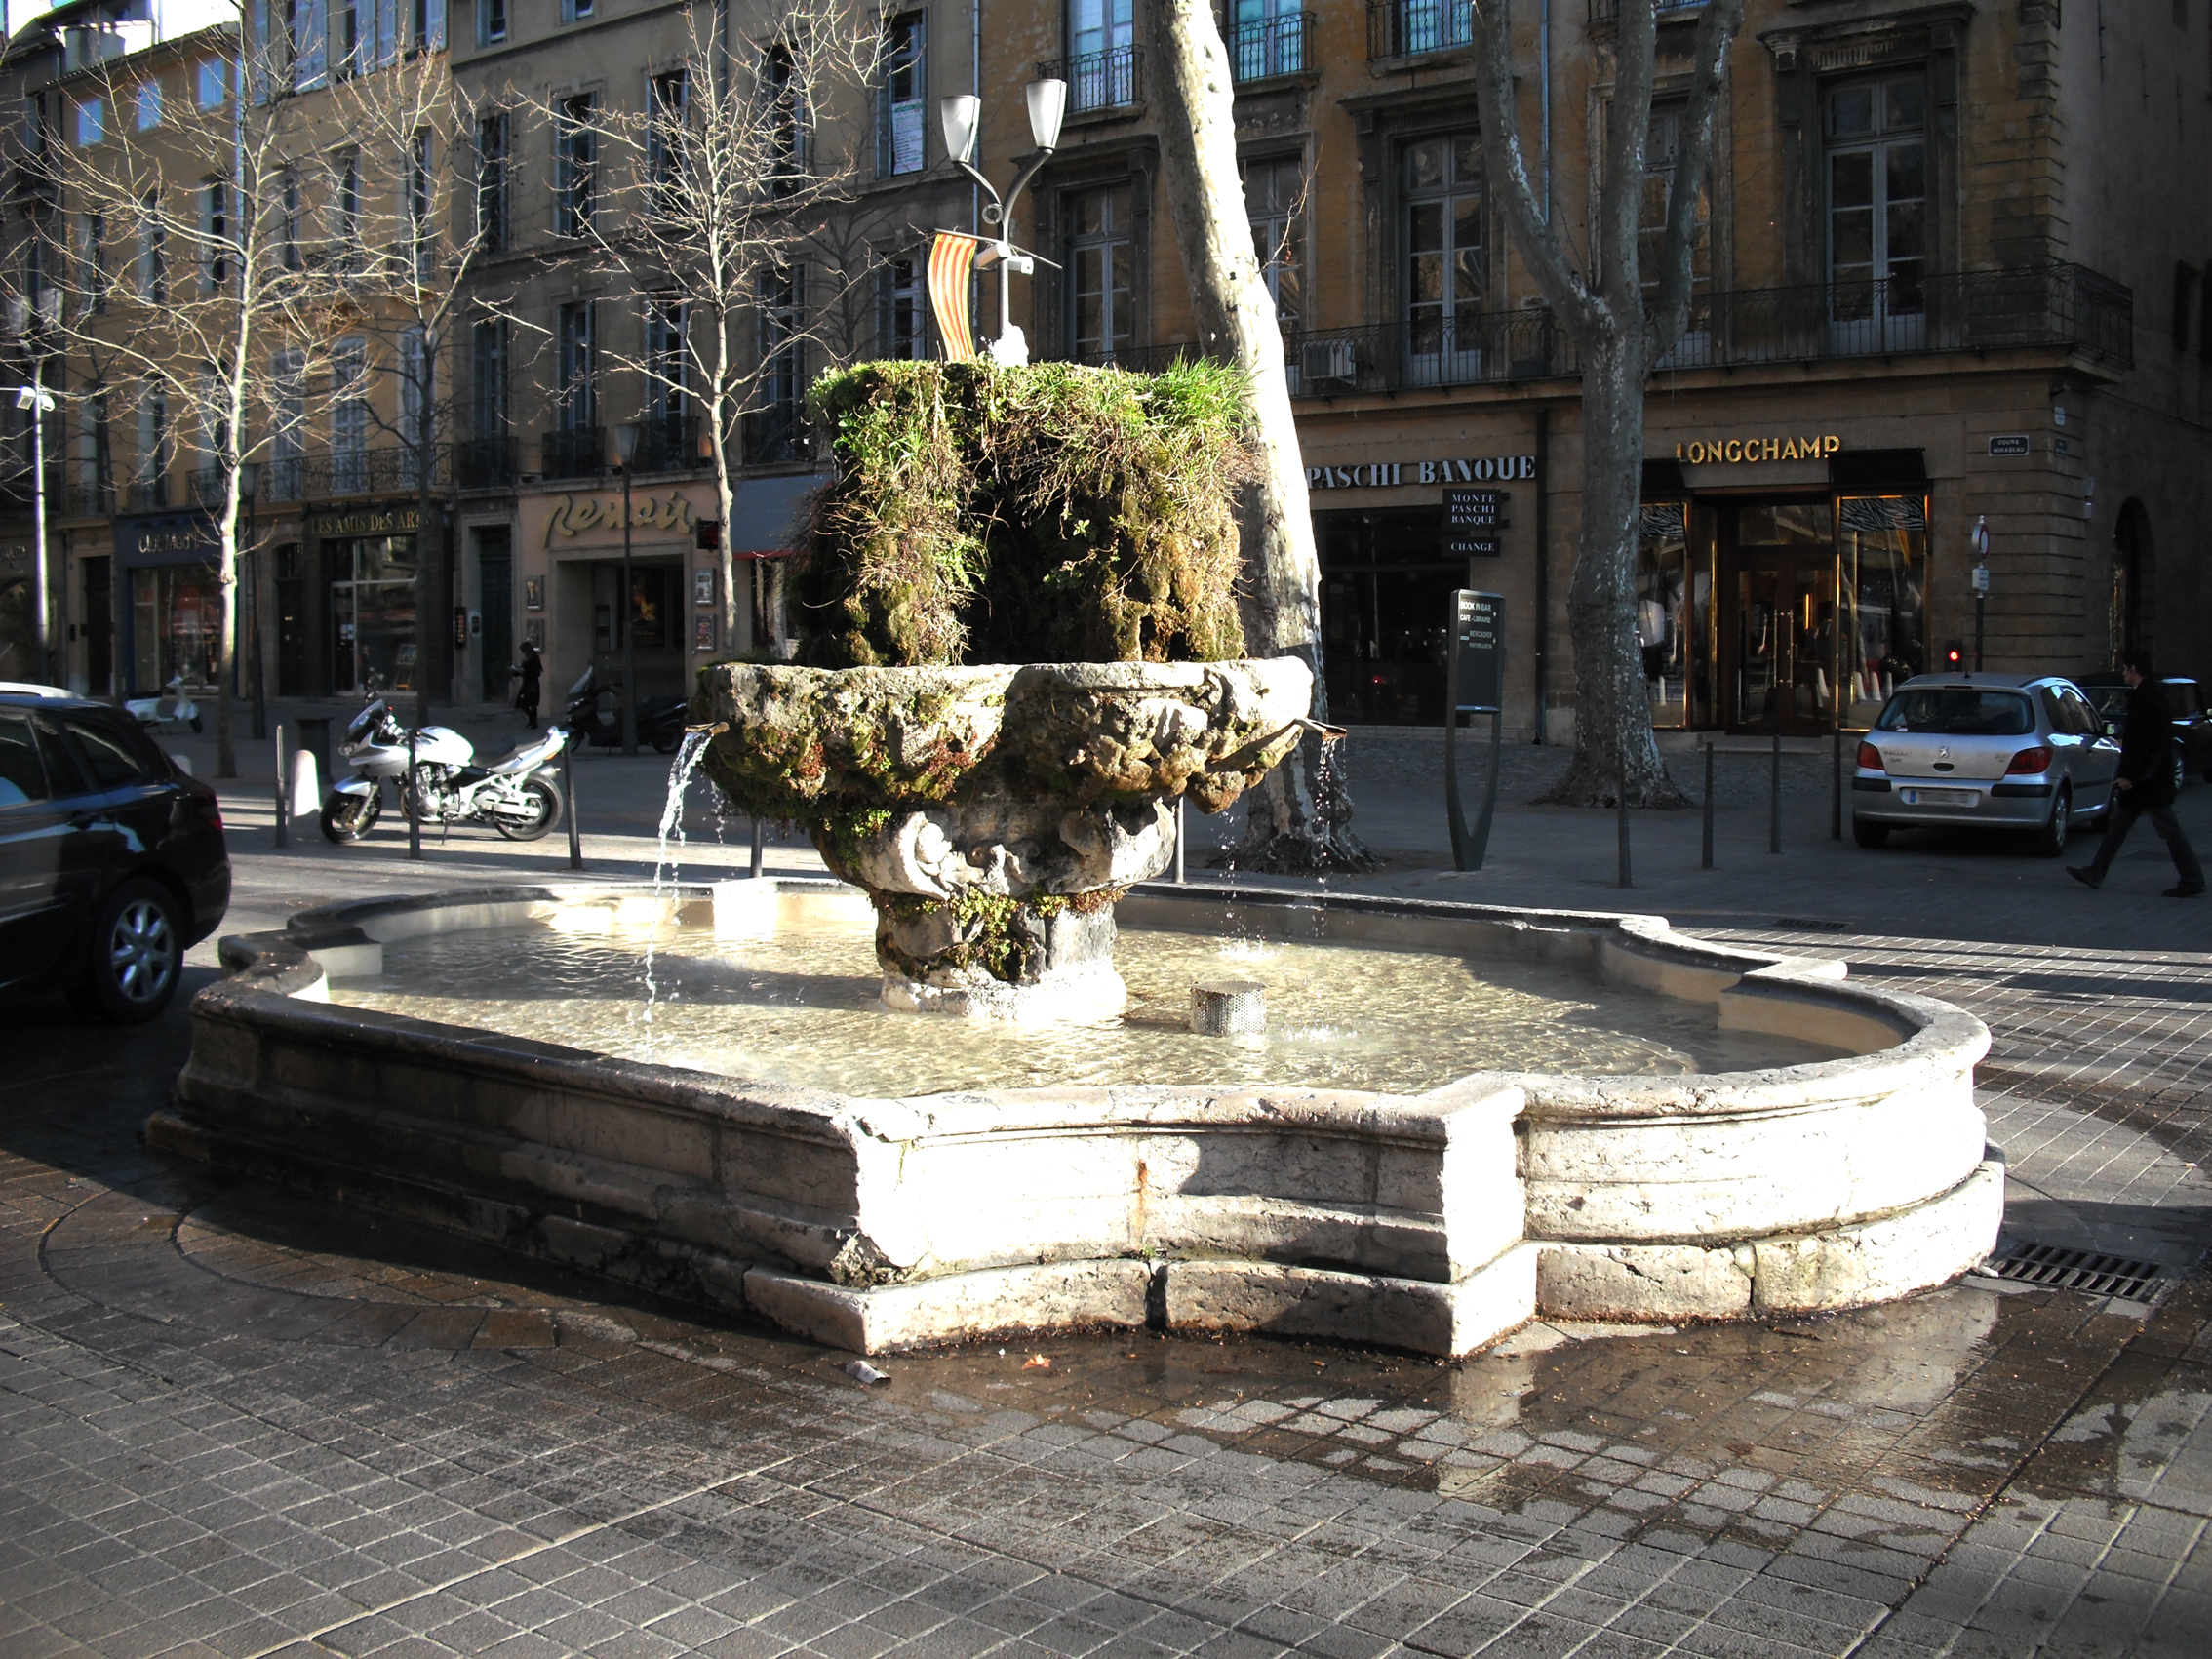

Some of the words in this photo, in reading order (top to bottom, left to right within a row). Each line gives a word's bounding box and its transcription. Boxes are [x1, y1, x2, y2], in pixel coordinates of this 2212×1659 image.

[1676, 435, 1841, 464] LONGCHAMP
[1306, 463, 1402, 489] PASCHI
[1418, 455, 1536, 485] BANQUE
[1451, 494, 1496, 503] MONTE
[1451, 504, 1496, 514] PASCHI
[311, 517, 333, 534] LES
[336, 515, 366, 533] AMIS
[370, 512, 394, 531] DES
[397, 510, 429, 529] ART
[541, 491, 694, 548] Renoir
[1451, 515, 1496, 526] BANQUE
[1450, 541, 1495, 552] CHANGE
[1460, 601, 1475, 611] BOOK
[1476, 602, 1481, 611] IN
[1481, 603, 1491, 612] BAR
